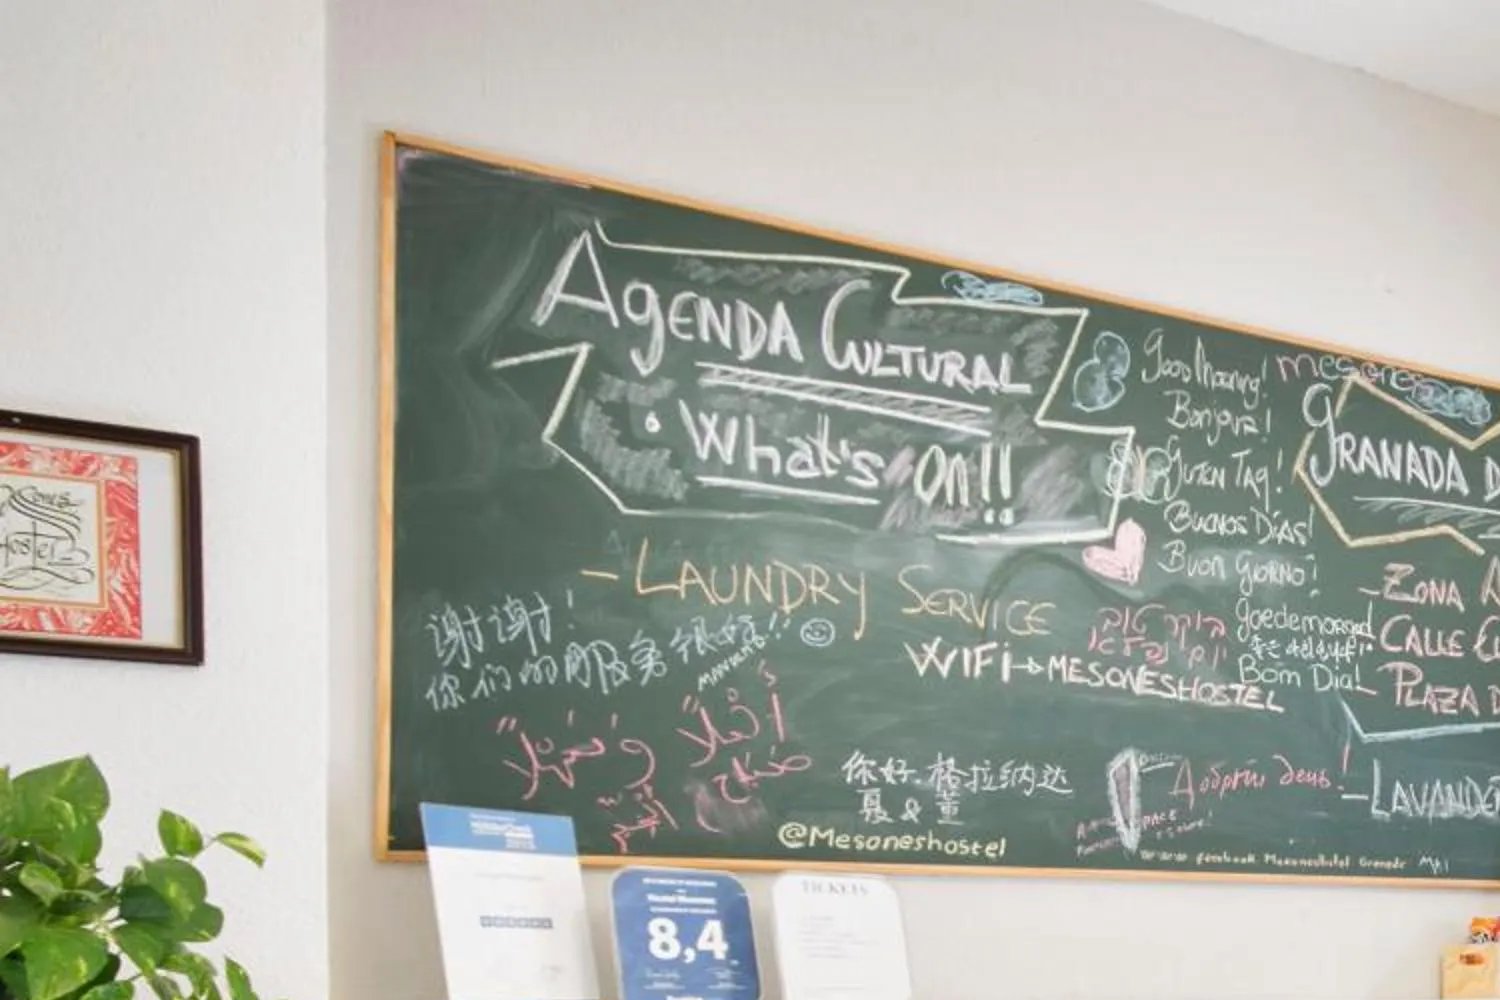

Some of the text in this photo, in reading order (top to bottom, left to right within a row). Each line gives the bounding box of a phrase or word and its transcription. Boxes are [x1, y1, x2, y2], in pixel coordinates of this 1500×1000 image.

[818, 279, 1032, 394] CULTURAL
[680, 400, 884, 485] What's
[897, 563, 1057, 637] SERVICE
[1384, 563, 1464, 611] ZONA
[1380, 615, 1466, 658] CALLE
[1047, 655, 1286, 713] MESONESHOSTEL
[1238, 653, 1301, 687] Bom
[1377, 662, 1480, 717] PLAZA
[648, 917, 728, 963] 8,4
